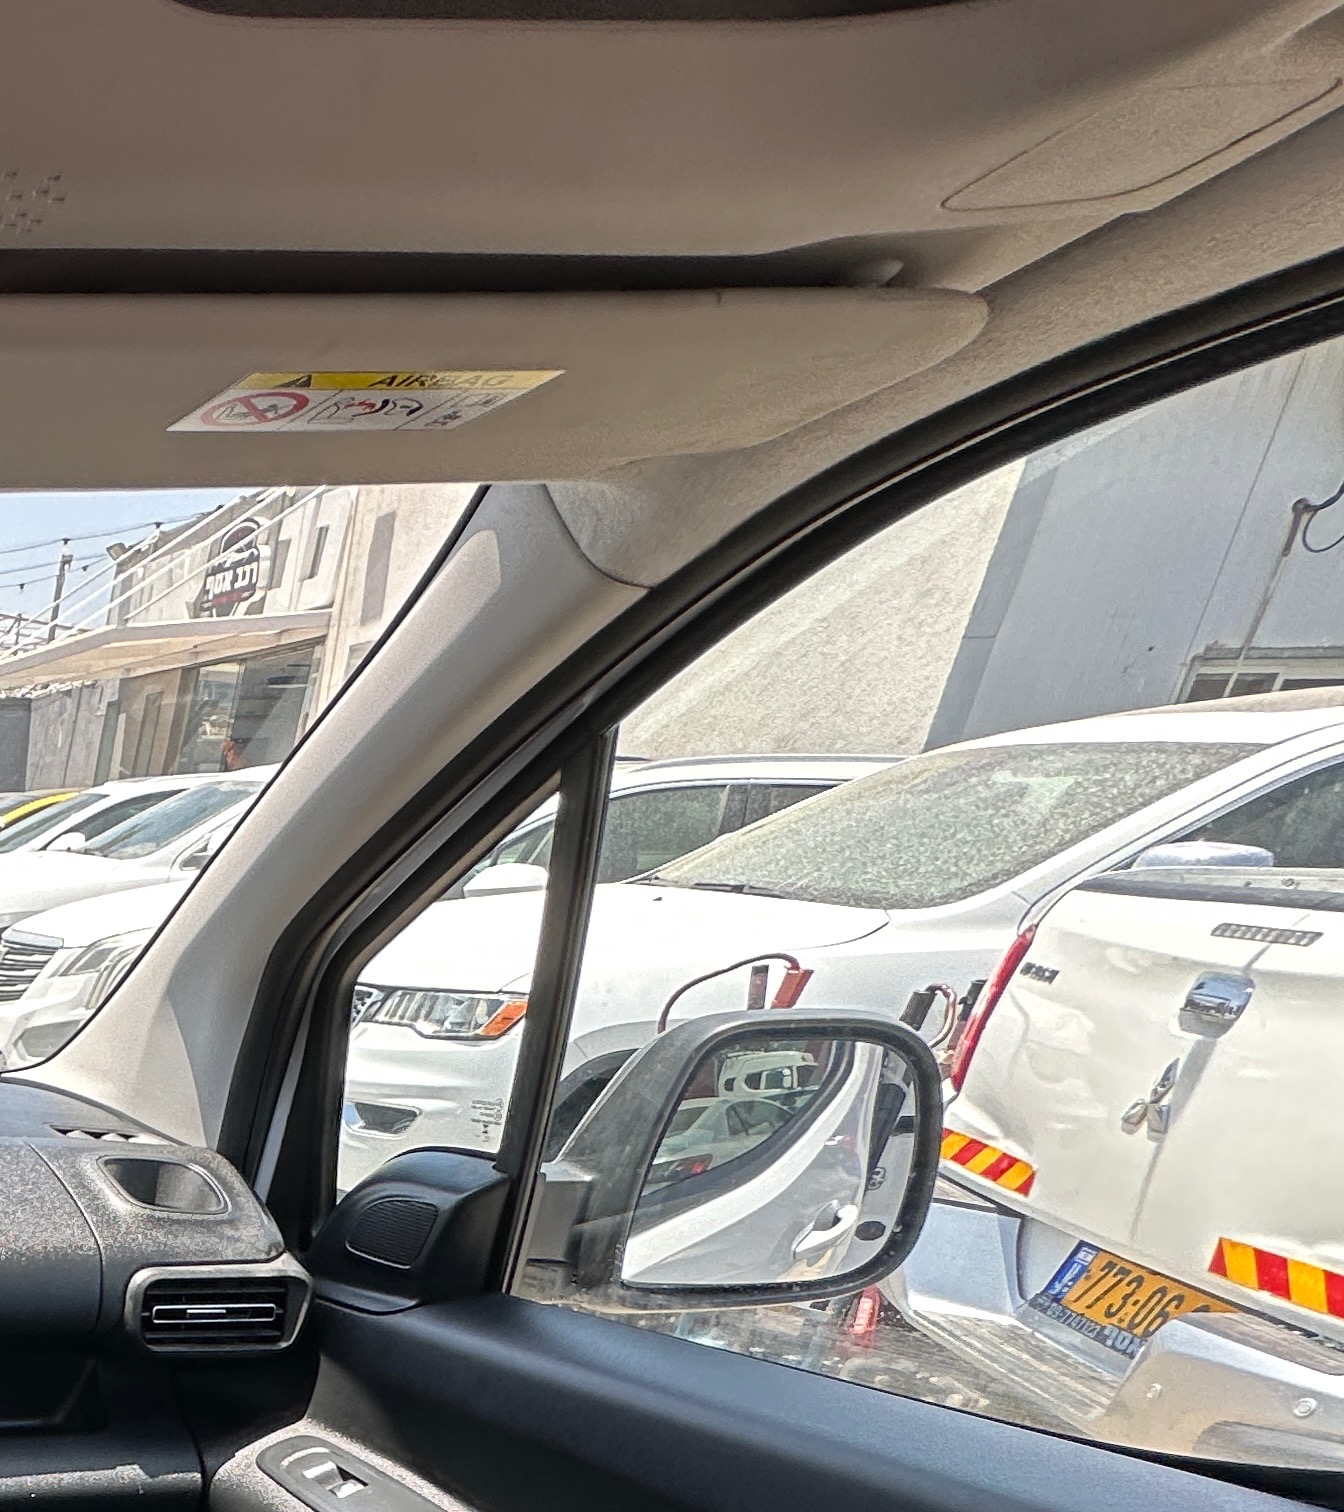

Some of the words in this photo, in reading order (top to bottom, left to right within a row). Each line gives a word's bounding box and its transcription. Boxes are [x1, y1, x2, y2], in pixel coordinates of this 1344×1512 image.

[368, 374, 514, 388] AIRBAG
[205, 569, 234, 601] אסף
[233, 561, 259, 590] רכב
